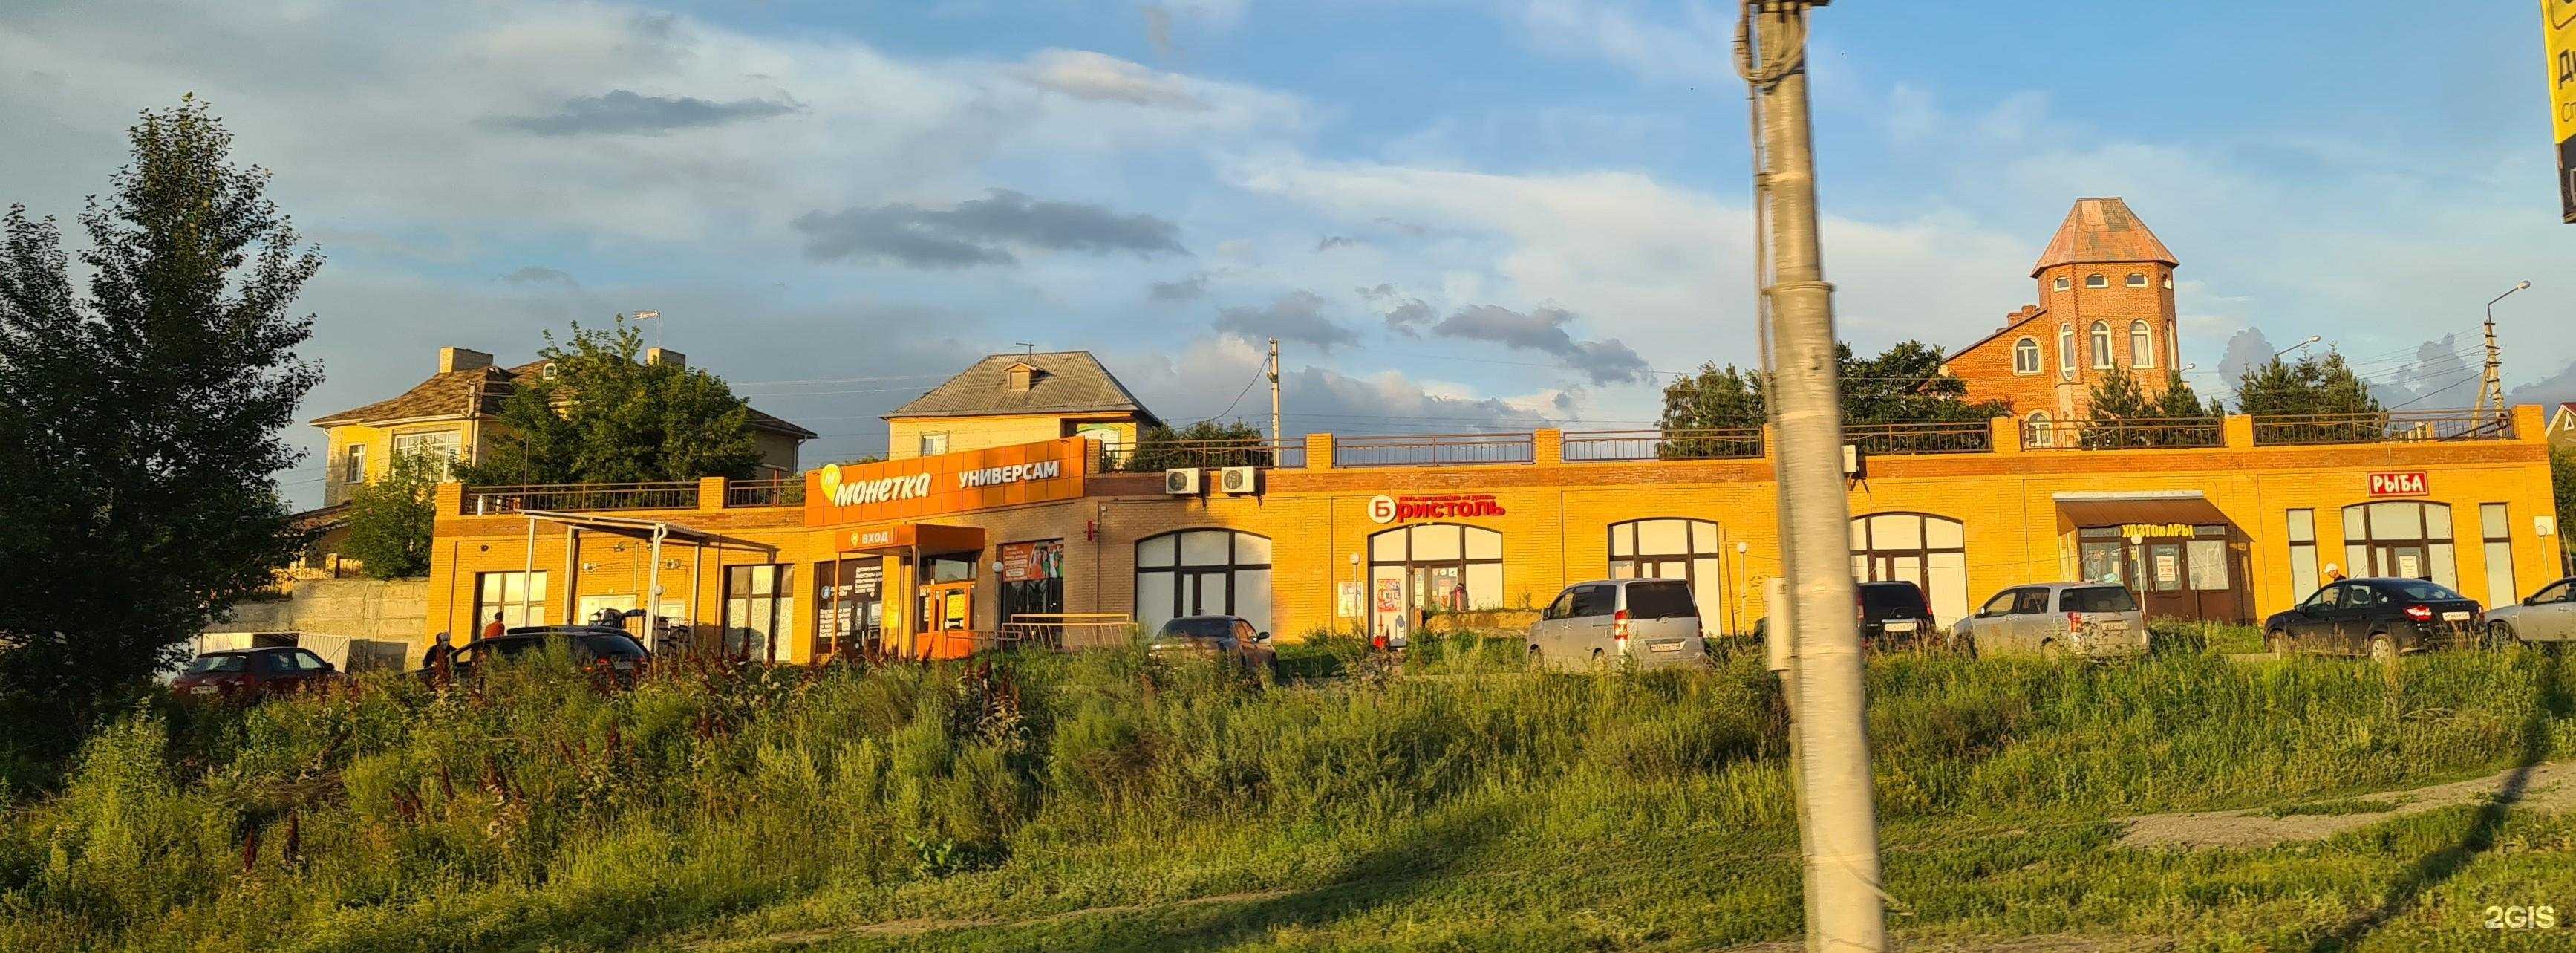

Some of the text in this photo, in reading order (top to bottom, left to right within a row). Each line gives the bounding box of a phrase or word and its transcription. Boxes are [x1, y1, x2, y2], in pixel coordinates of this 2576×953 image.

[958, 460, 1060, 489] УНИВЕРСАМ
[2372, 474, 2424, 492] РЫБА
[862, 531, 888, 544] ВХОД
[2122, 523, 2194, 538] ХОЗТОВАРЫ
